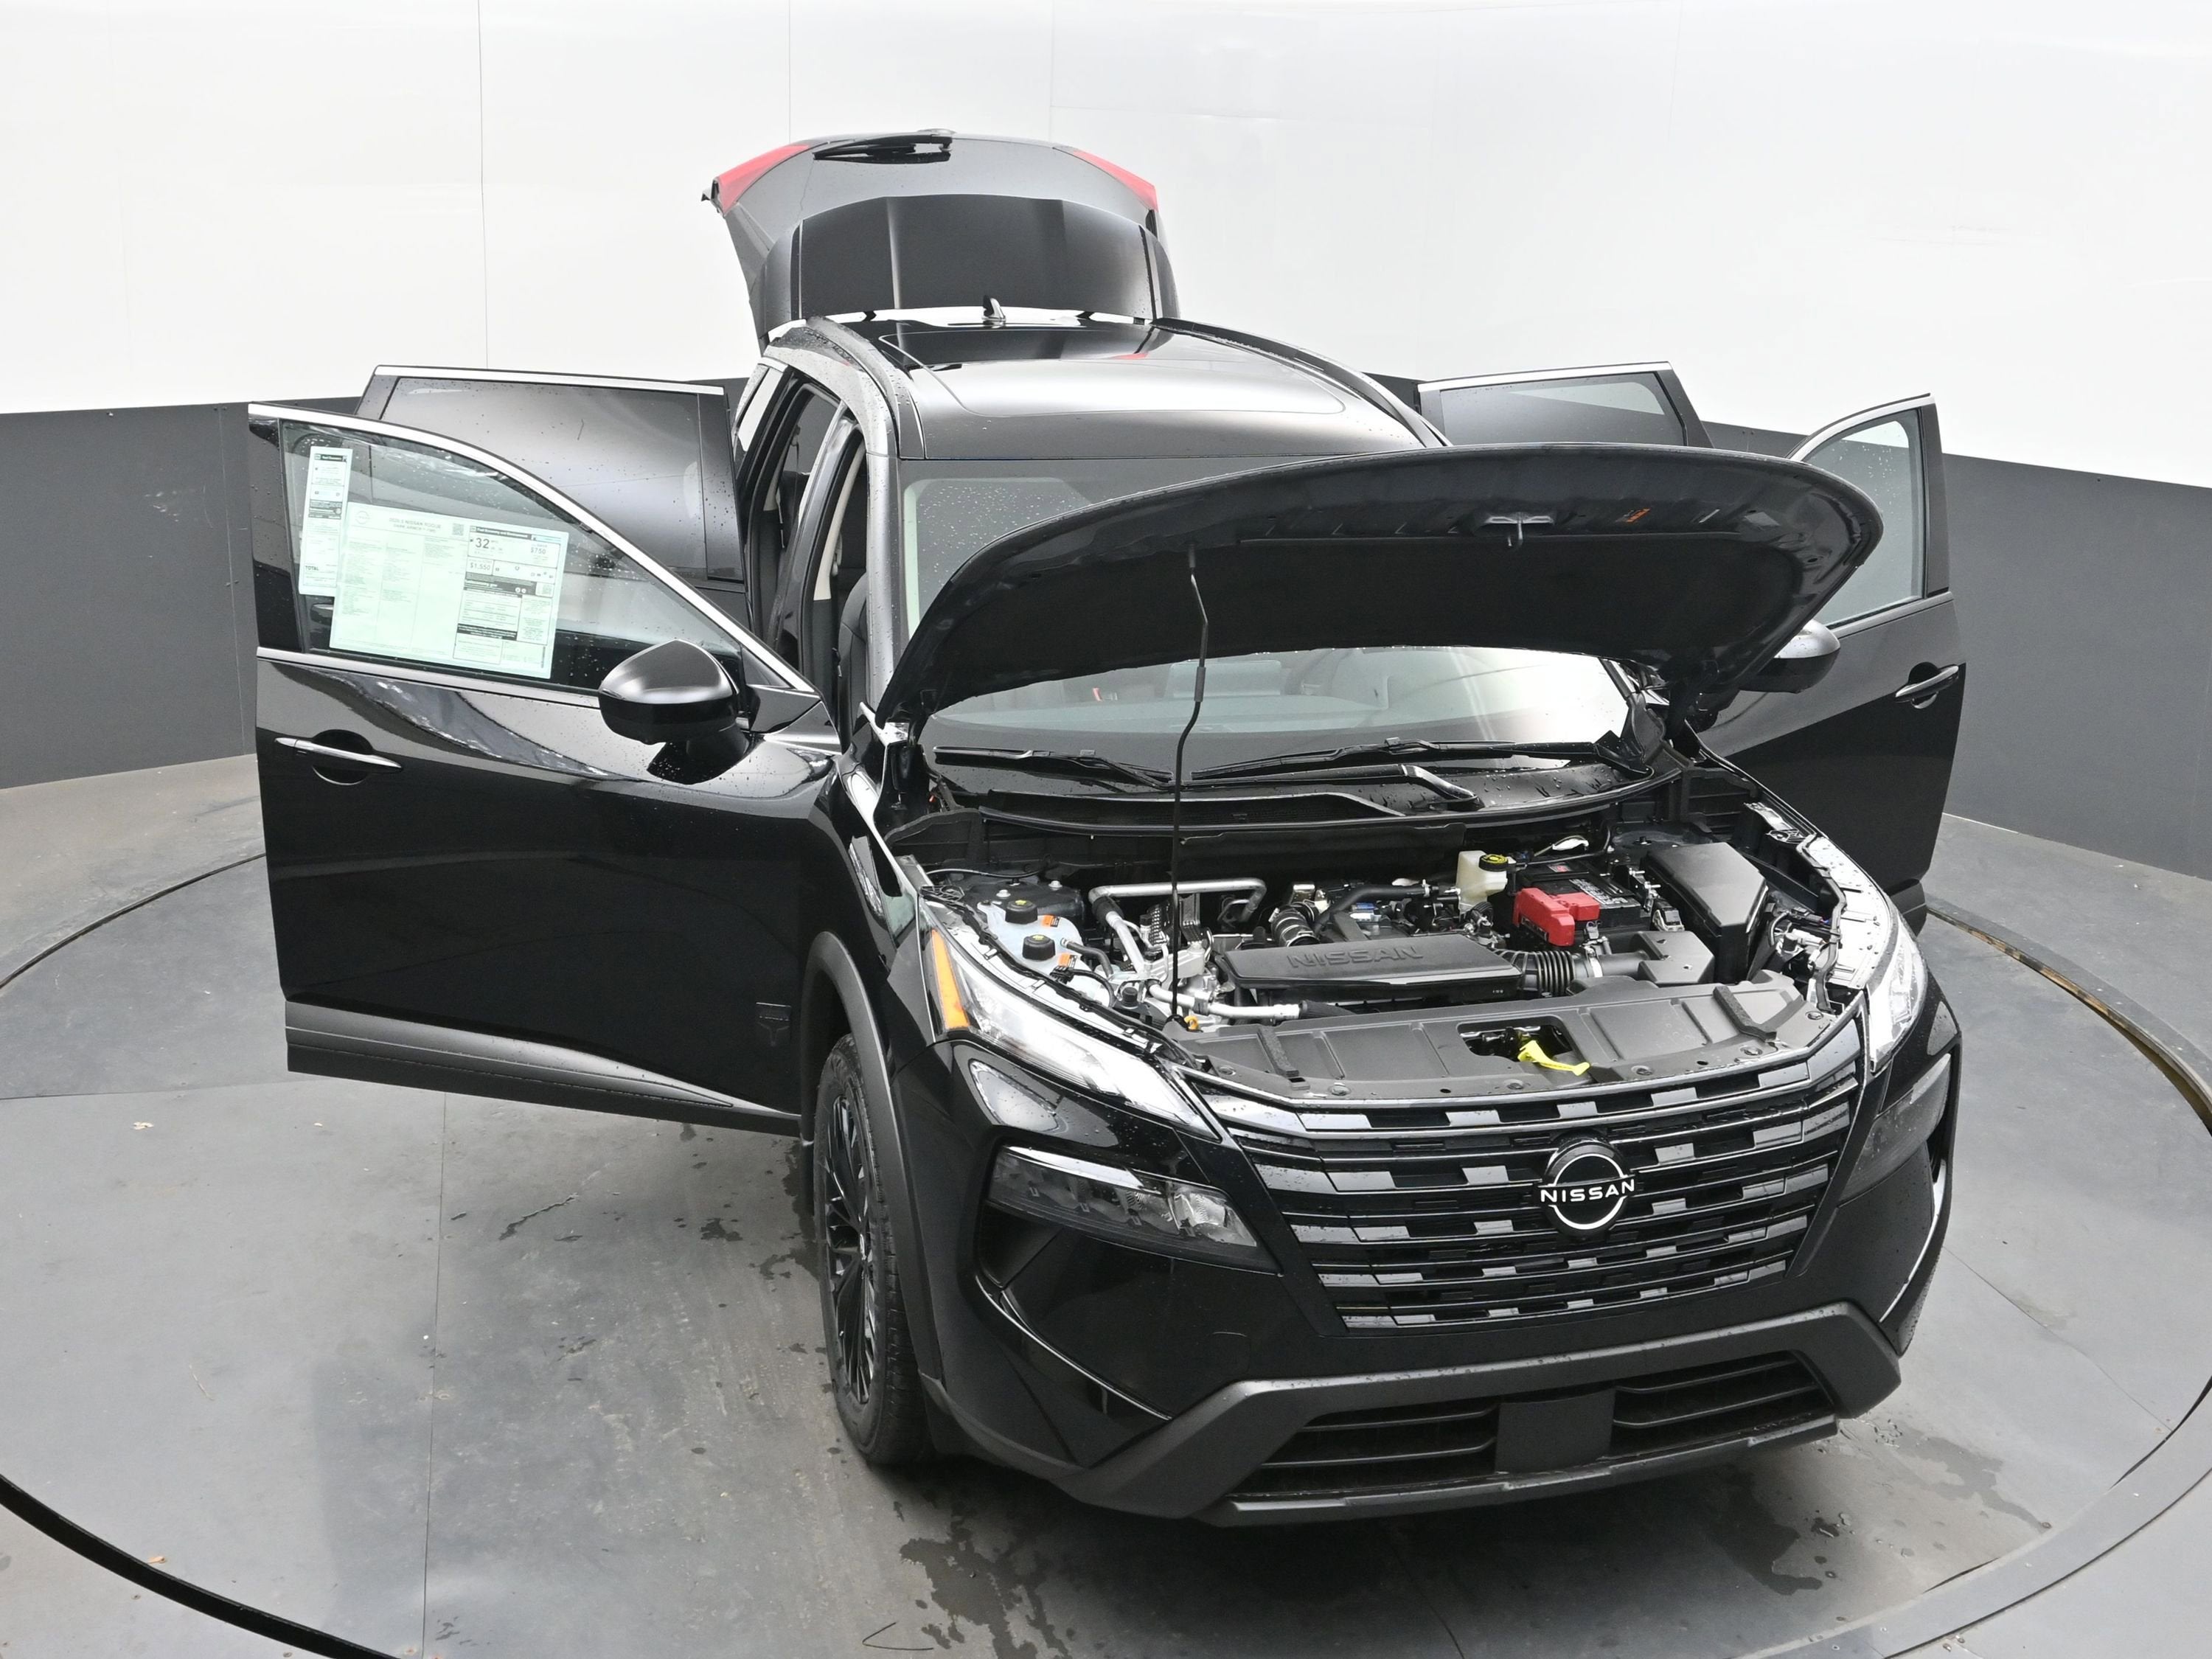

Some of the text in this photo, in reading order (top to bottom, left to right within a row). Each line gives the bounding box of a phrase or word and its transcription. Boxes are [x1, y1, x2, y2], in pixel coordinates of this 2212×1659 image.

[475, 538, 490, 549] 32
[530, 546, 546, 554] $750
[1287, 945, 1424, 968] NISSAN
[1540, 1178, 1635, 1203] NISSAN
